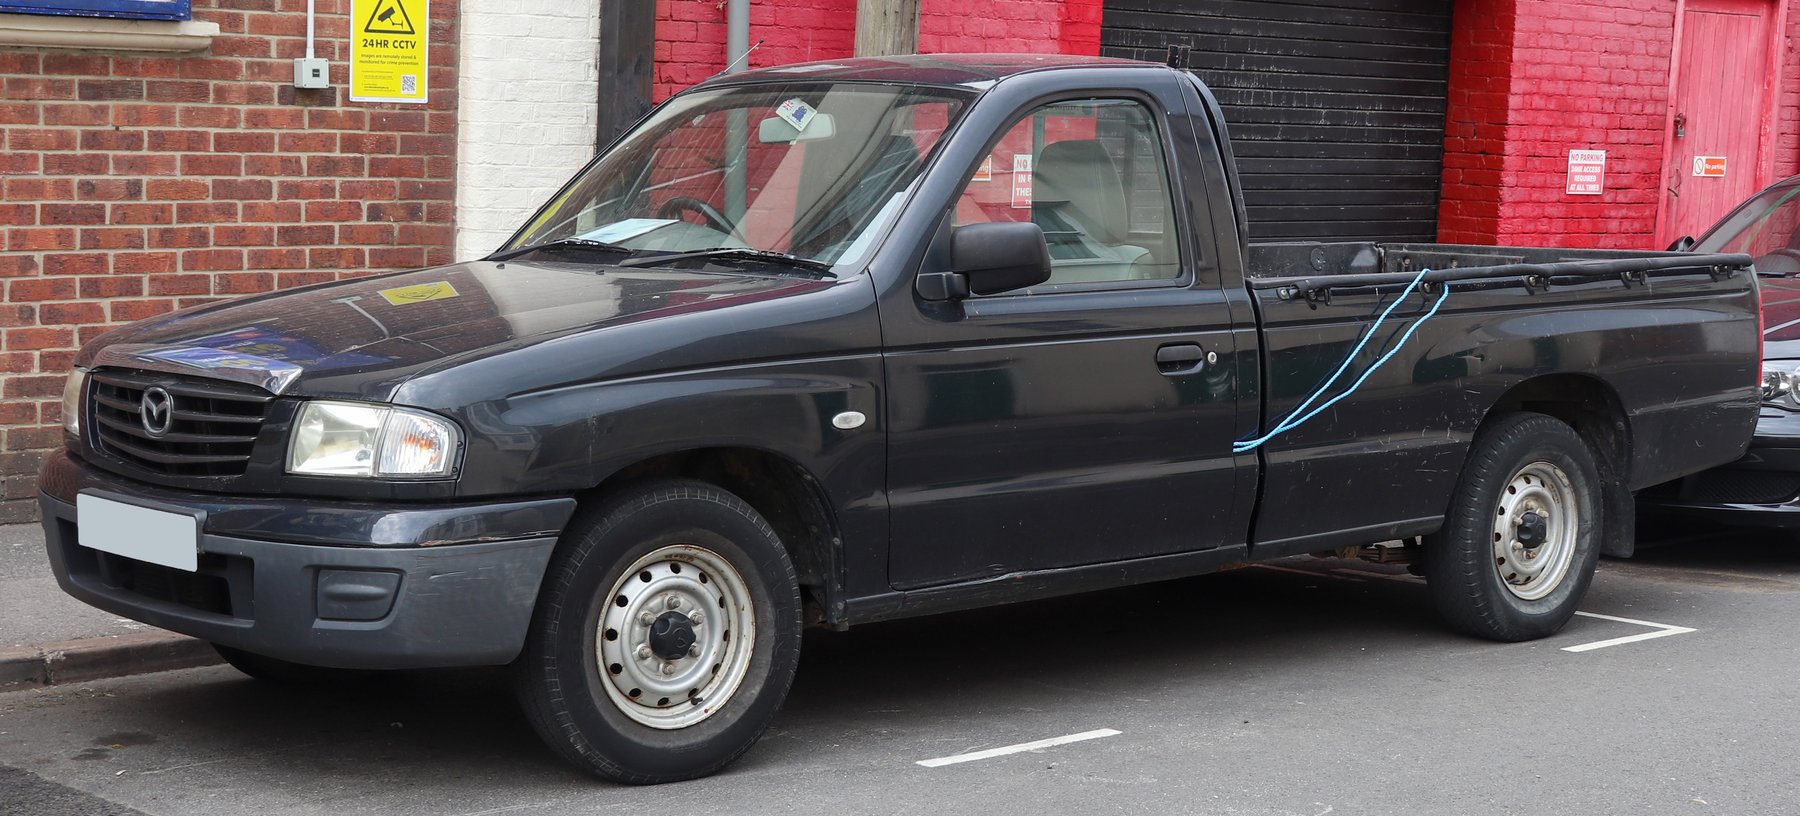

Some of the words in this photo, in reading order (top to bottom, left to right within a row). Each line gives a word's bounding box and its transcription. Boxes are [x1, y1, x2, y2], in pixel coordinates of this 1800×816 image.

[362, 39, 389, 48] 24HR
[392, 40, 417, 49] CCTV
[1571, 153, 1579, 161] NO
[1580, 153, 1604, 162] PARKING
[1017, 159, 1028, 168] NO
[1018, 174, 1026, 183] IN
[1576, 183, 1586, 191] ALL
